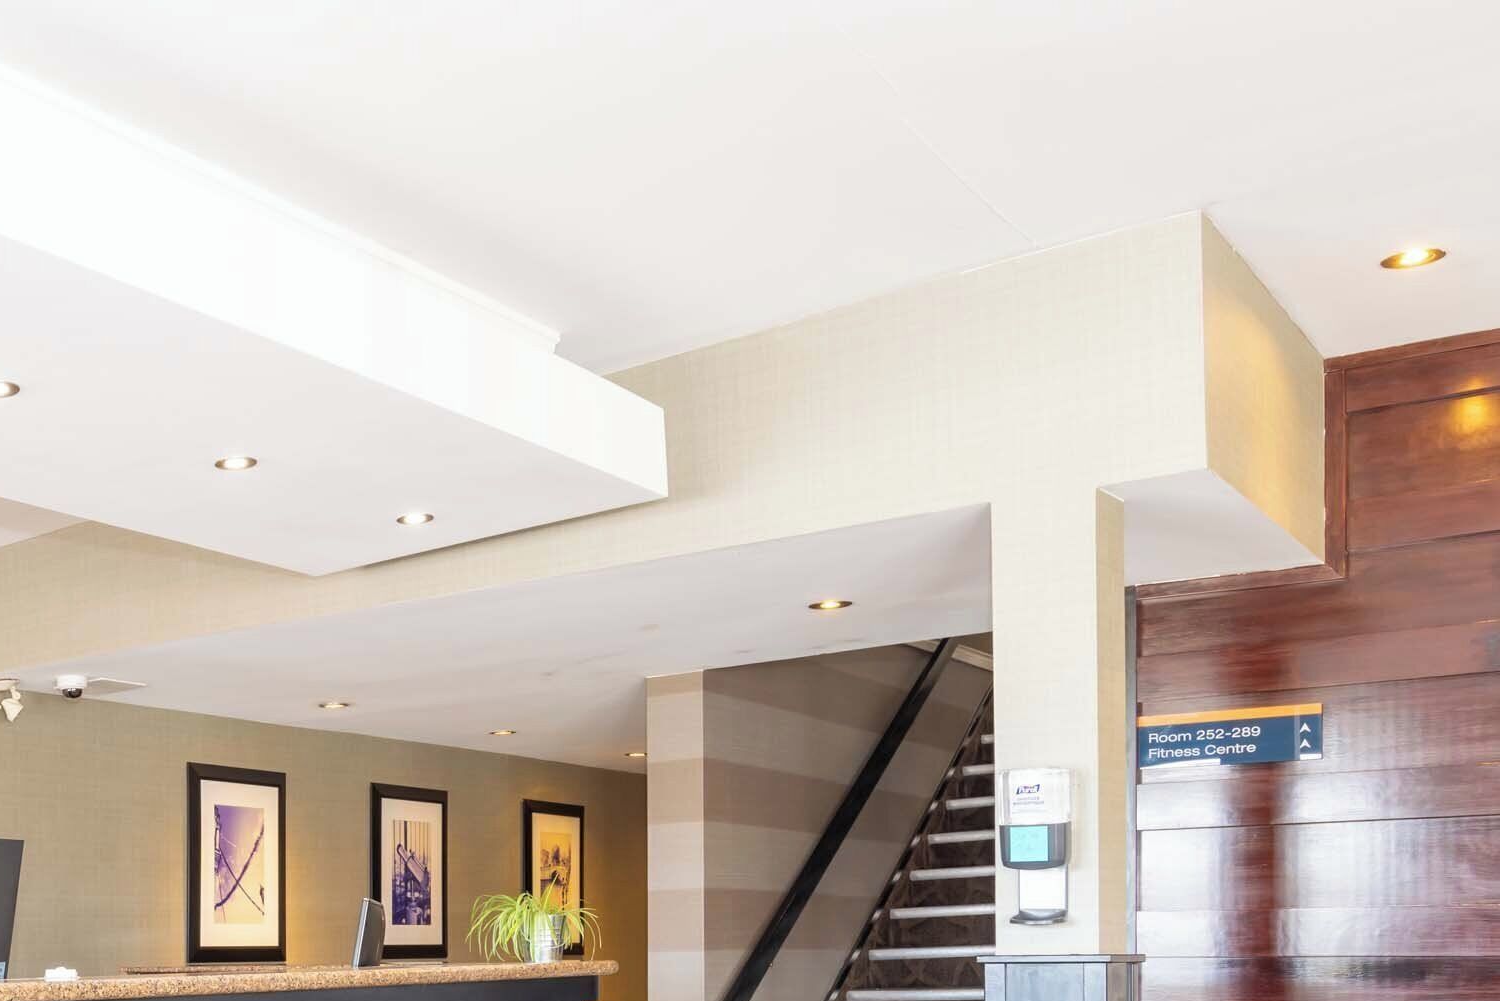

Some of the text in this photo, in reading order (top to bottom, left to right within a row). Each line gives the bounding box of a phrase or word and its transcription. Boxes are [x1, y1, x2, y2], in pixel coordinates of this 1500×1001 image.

[1148, 726, 1261, 743] Room 252-289
[1148, 743, 1257, 759] Fitness Centre
